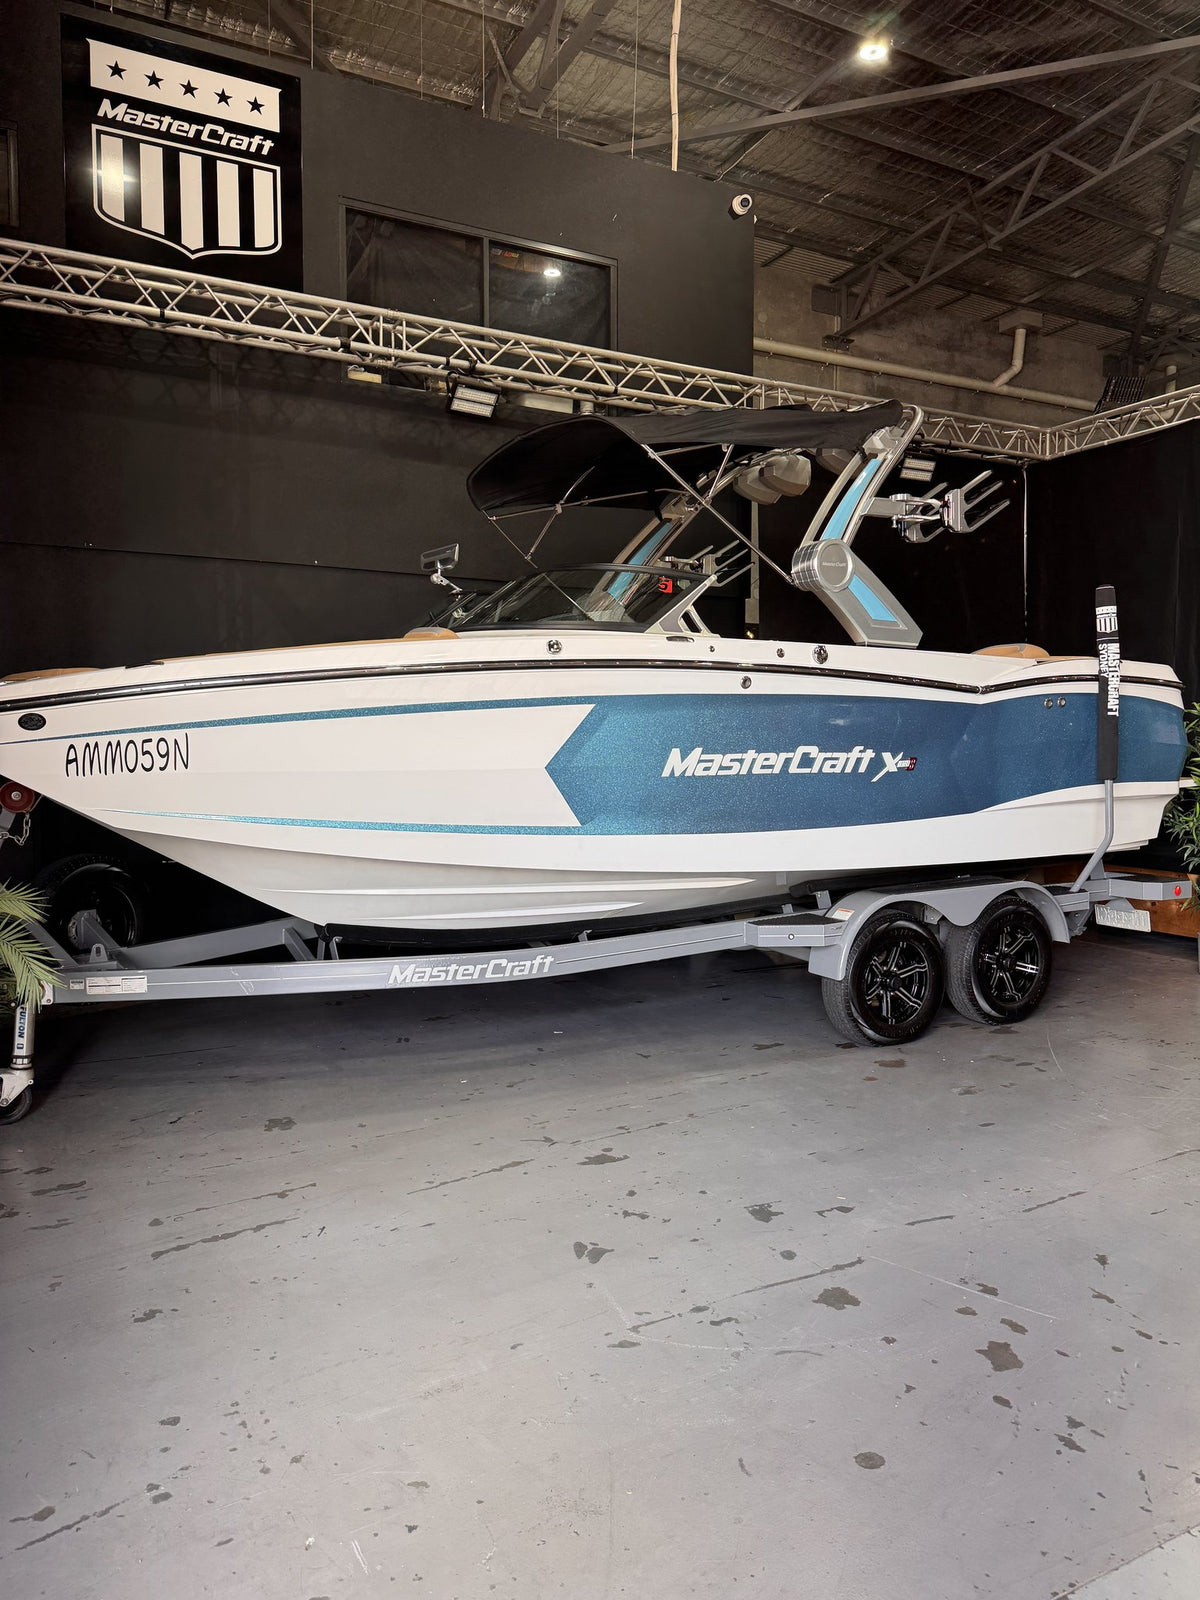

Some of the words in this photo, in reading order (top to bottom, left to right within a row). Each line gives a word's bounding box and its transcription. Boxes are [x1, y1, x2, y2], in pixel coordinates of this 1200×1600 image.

[97, 98, 274, 155] MasterCraft
[1098, 643, 1109, 678] SYDNEY
[661, 745, 875, 777] MasterCraft
[388, 955, 554, 985] MasterCraft
